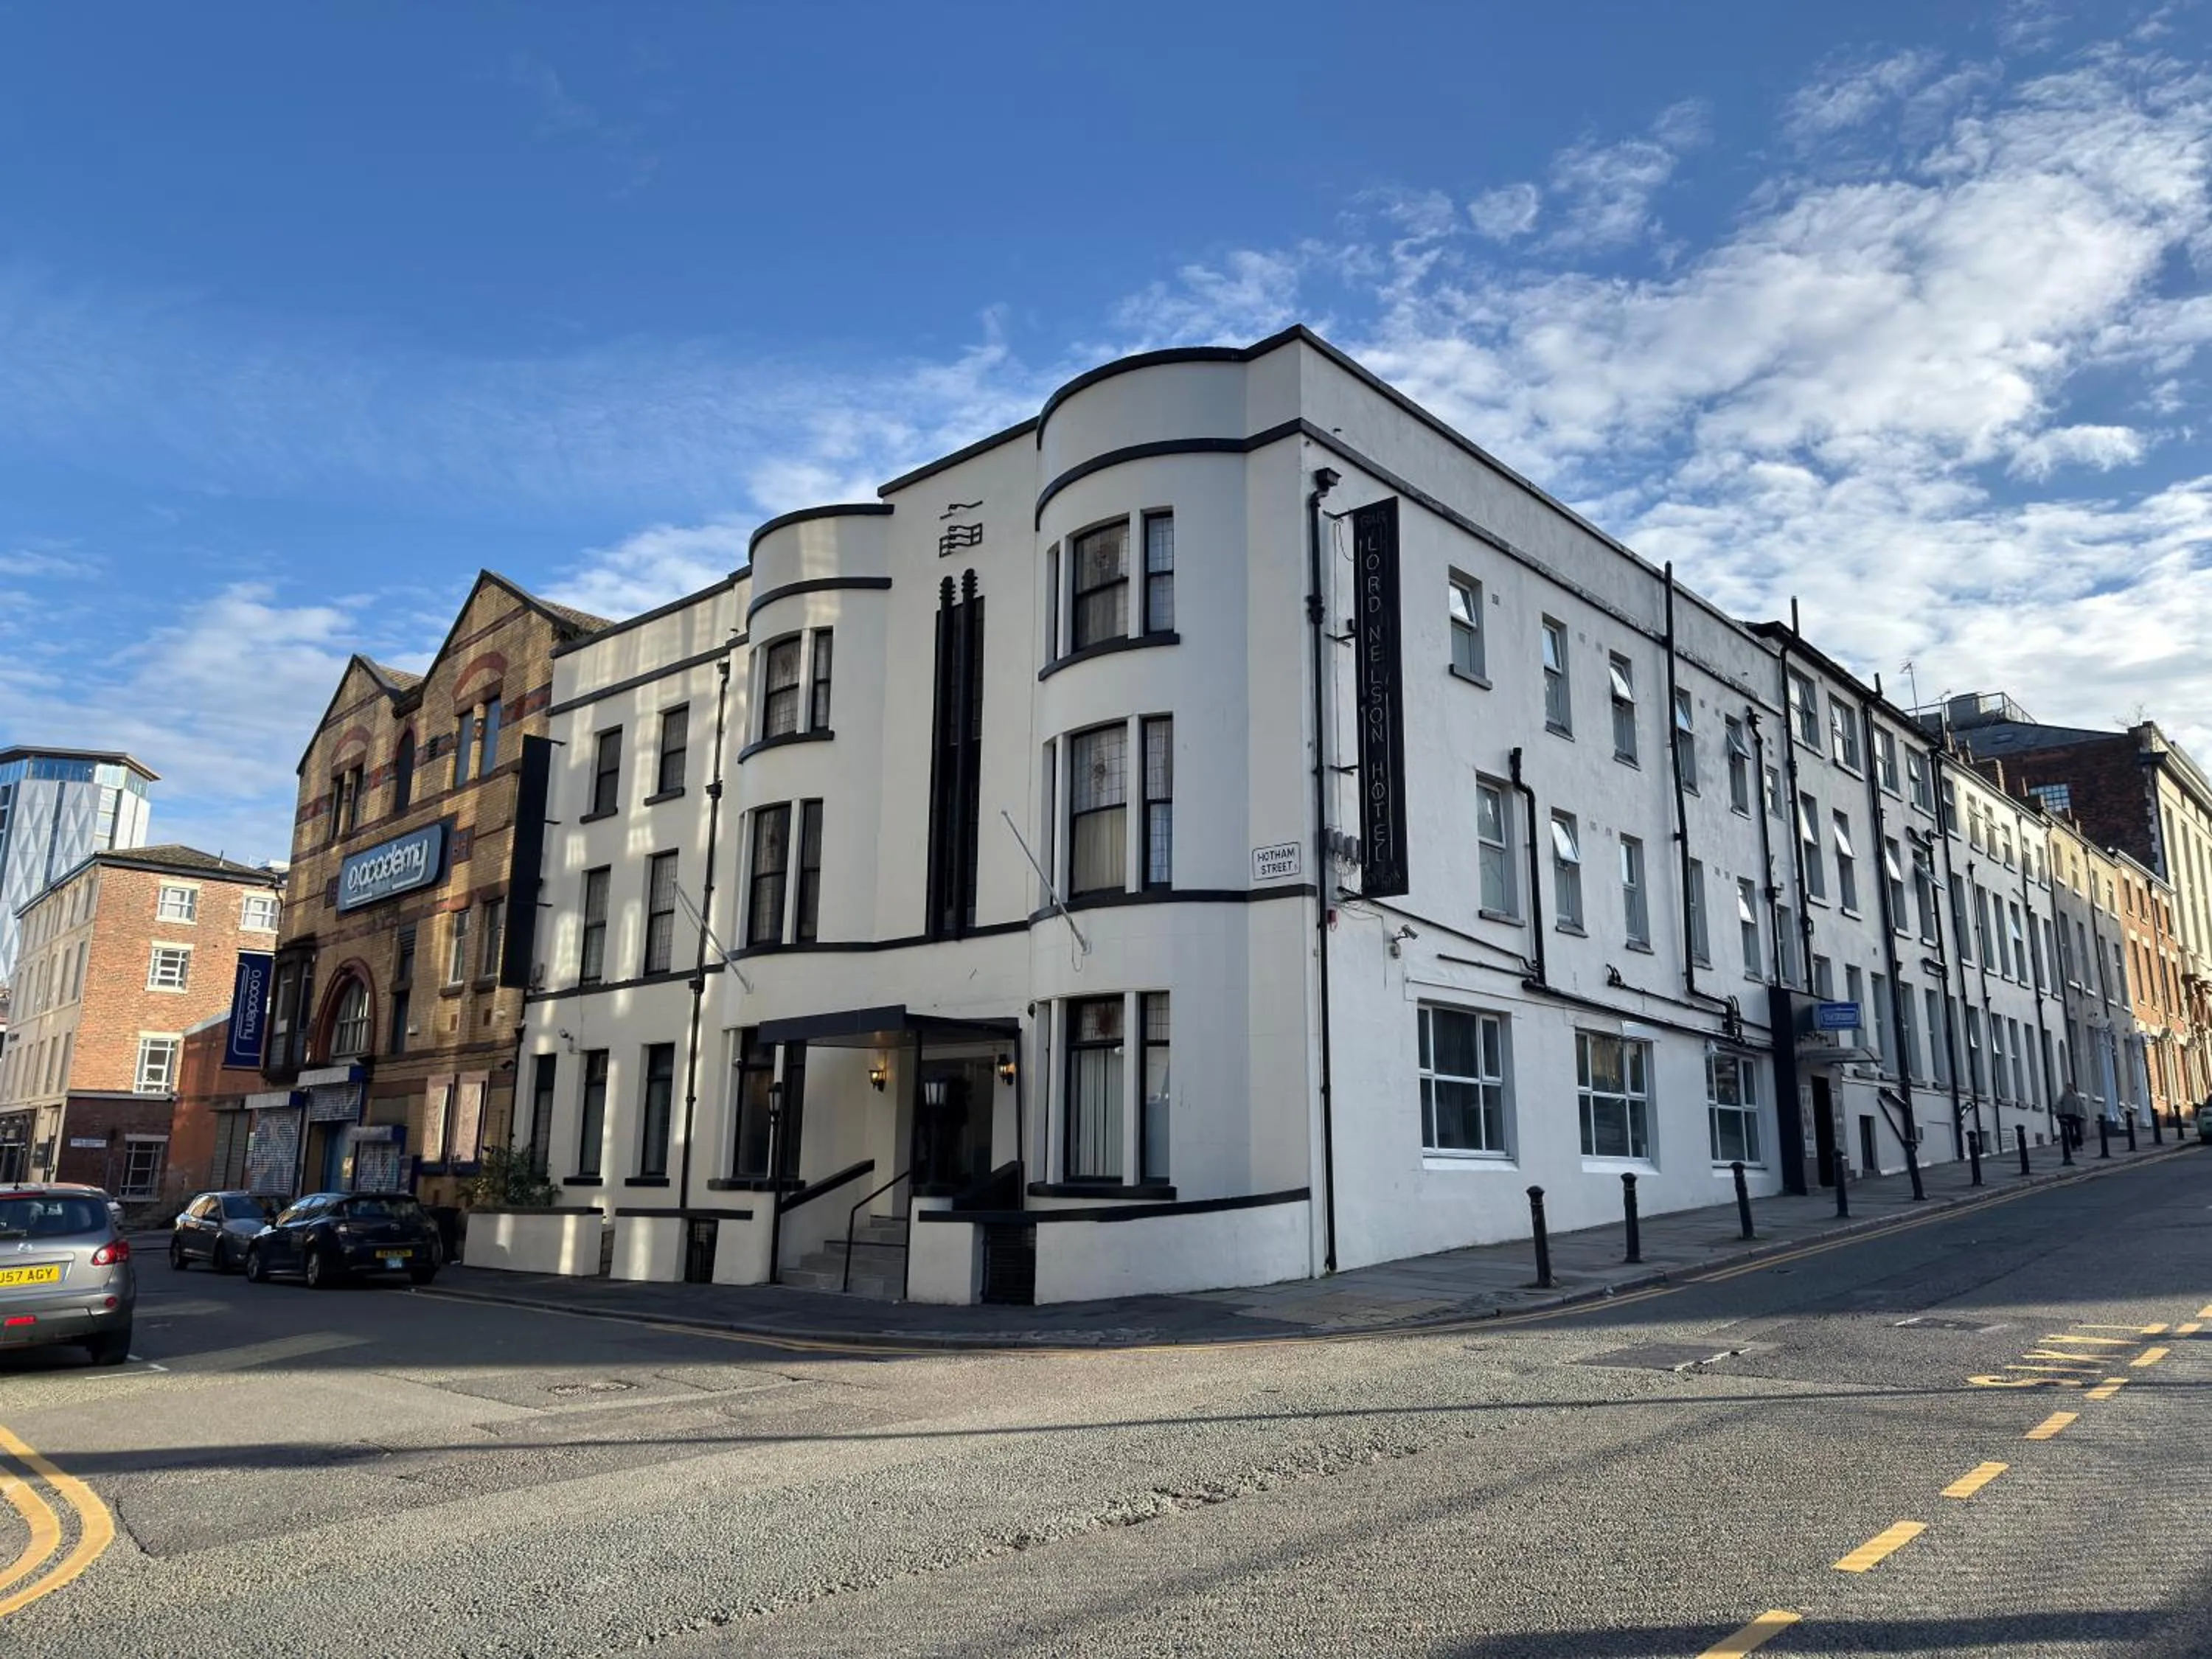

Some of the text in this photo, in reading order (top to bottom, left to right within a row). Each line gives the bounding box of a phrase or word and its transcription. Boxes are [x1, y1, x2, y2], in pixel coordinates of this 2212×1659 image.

[1366, 535, 1381, 613] LORD
[1368, 625, 1384, 744] NELSON
[1371, 760, 1386, 862] HOTEL
[1256, 847, 1295, 862] HOTHAM
[1261, 860, 1293, 875] STREET
[27, 1267, 54, 1281] AGY
